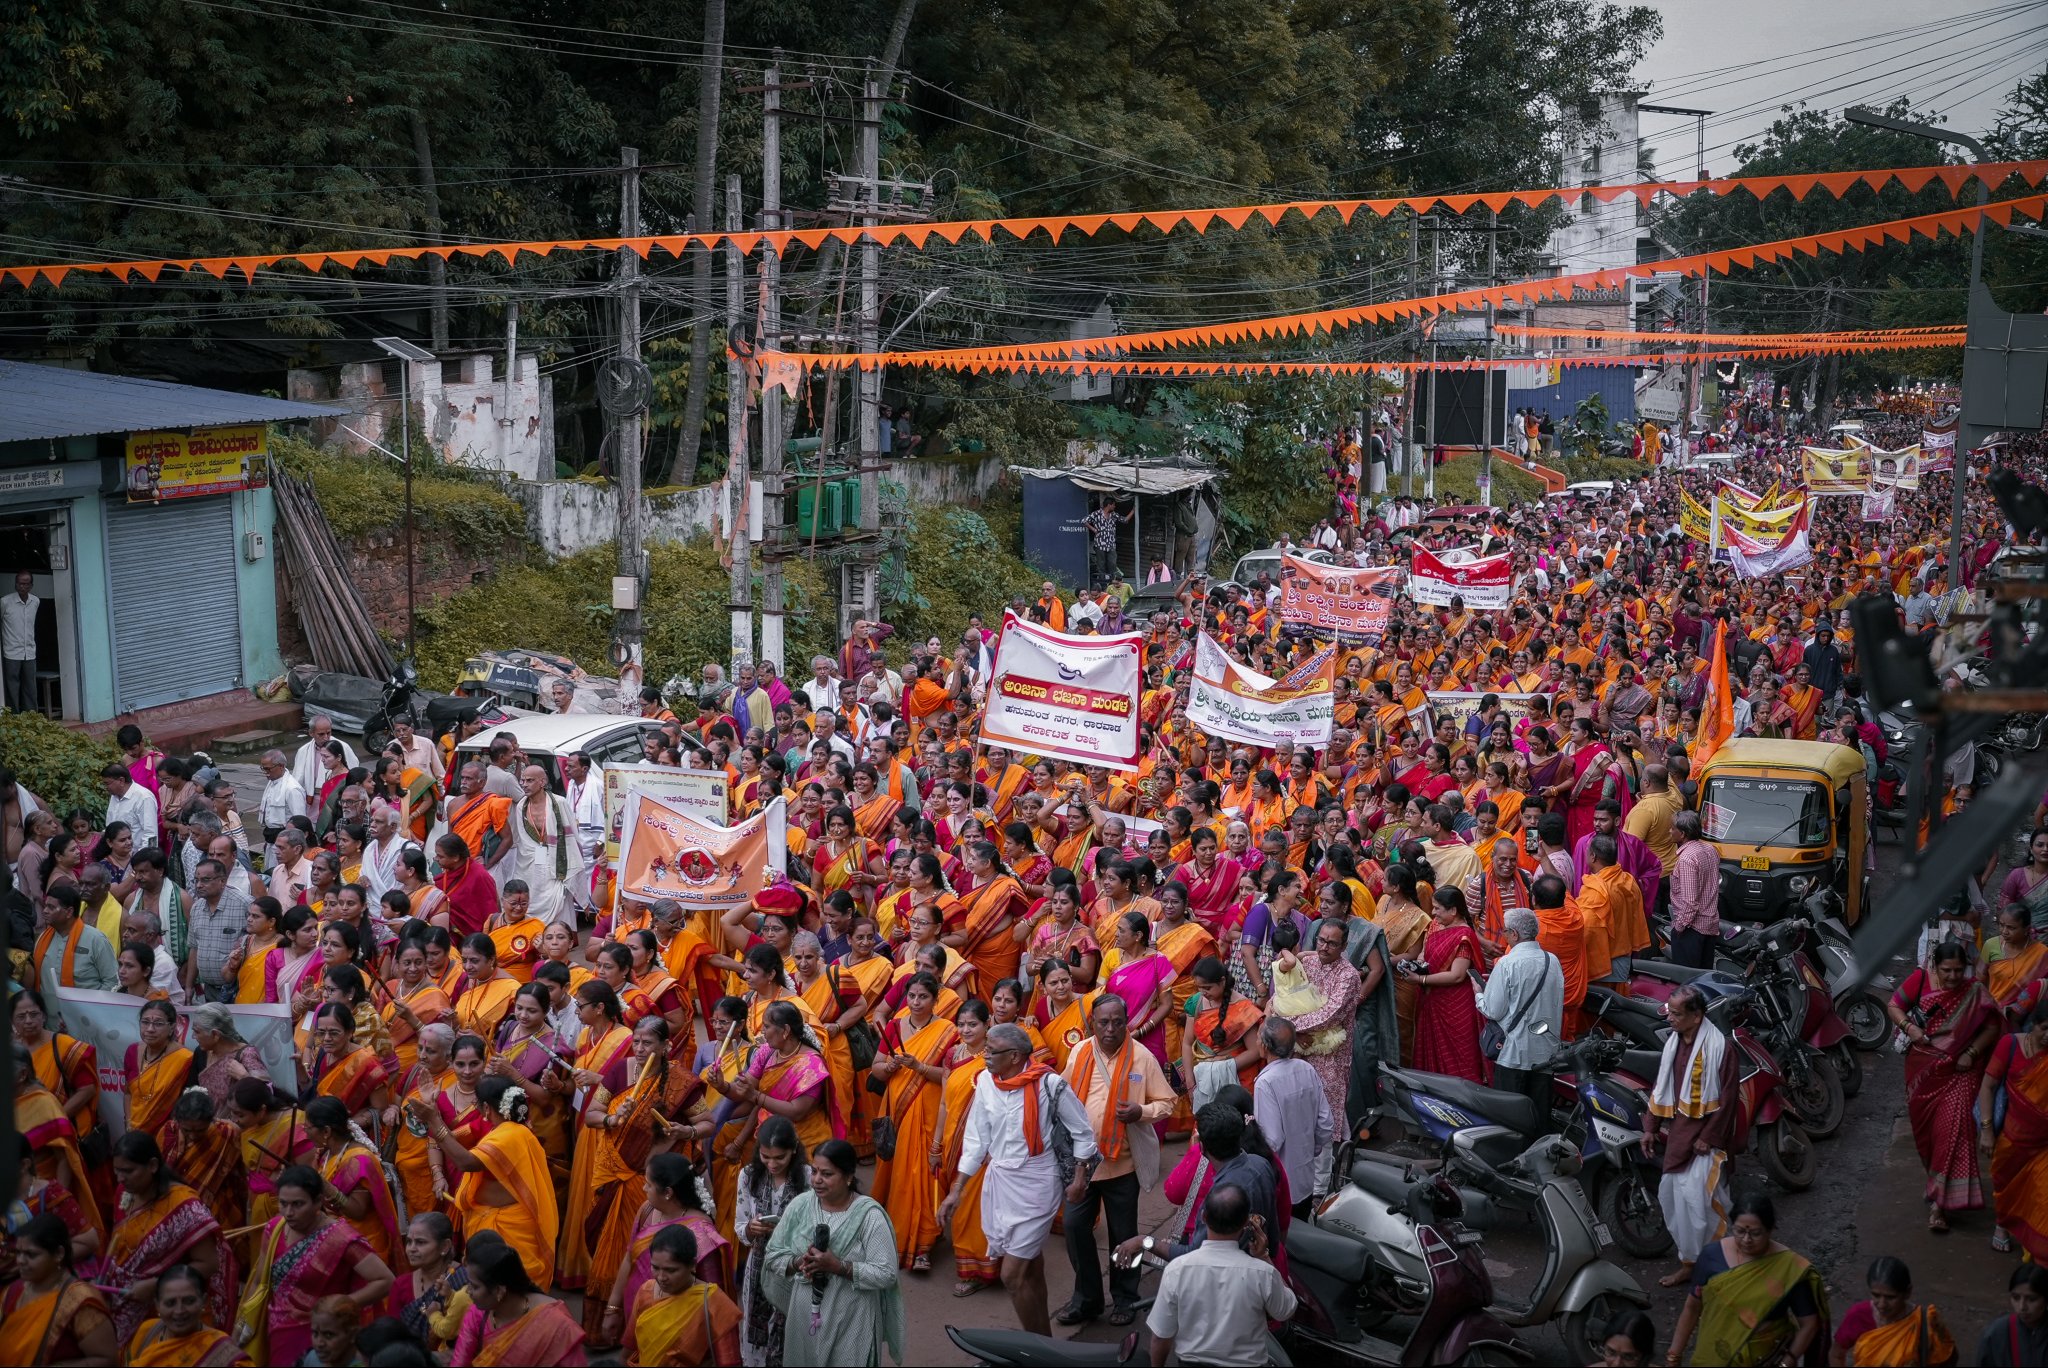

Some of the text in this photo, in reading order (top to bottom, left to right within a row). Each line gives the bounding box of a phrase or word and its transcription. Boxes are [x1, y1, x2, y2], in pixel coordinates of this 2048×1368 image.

[1004, 679, 1047, 699] ಅಂಜನಾ
[1053, 689, 1087, 705] ಭಜನಾ
[1194, 688, 1209, 707] ಶ್ರೀ
[1005, 705, 1049, 720] ಹನುಮಂತ
[1084, 719, 1121, 732] ಧಾರವಾಡ
[1023, 724, 1100, 750] ಕರ್ನಾಟಕ ರಾಜ್ಯ
[1601, 1132, 1620, 1143] YAMAHA
